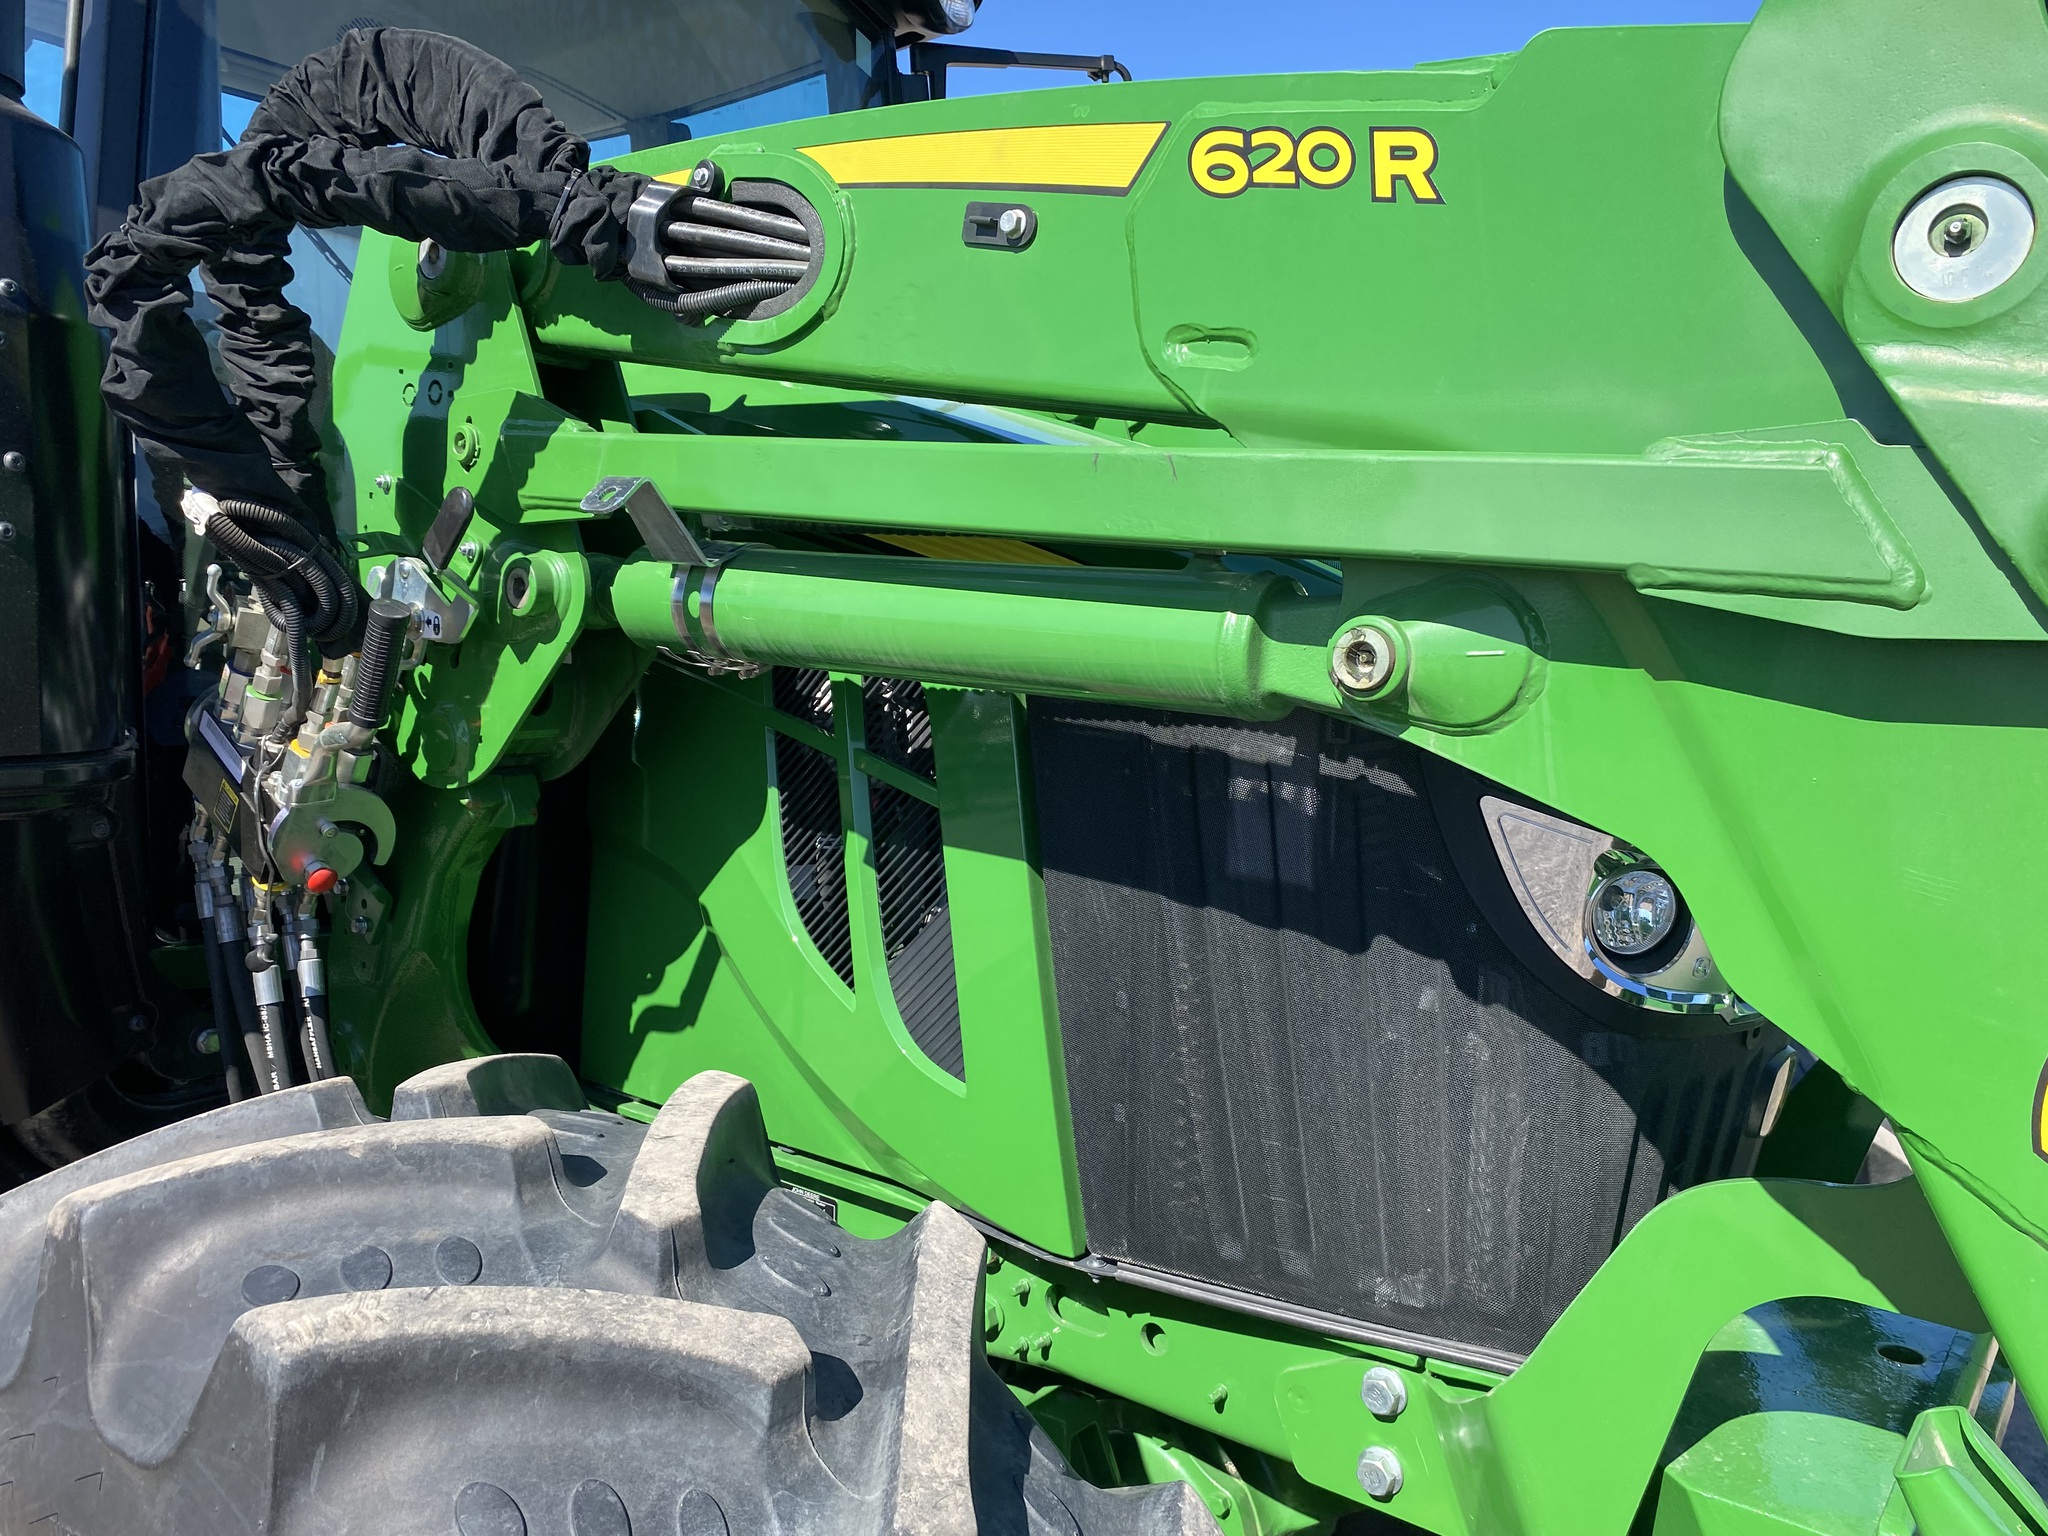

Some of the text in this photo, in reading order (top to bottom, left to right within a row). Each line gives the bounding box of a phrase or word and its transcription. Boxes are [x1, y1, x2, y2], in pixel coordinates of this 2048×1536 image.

[1188, 126, 1446, 204] 620 R
[691, 266, 711, 274] MADE
[730, 267, 754, 275] ITALY
[264, 1033, 274, 1058] MSHA
[271, 1071, 280, 1090] BAR
